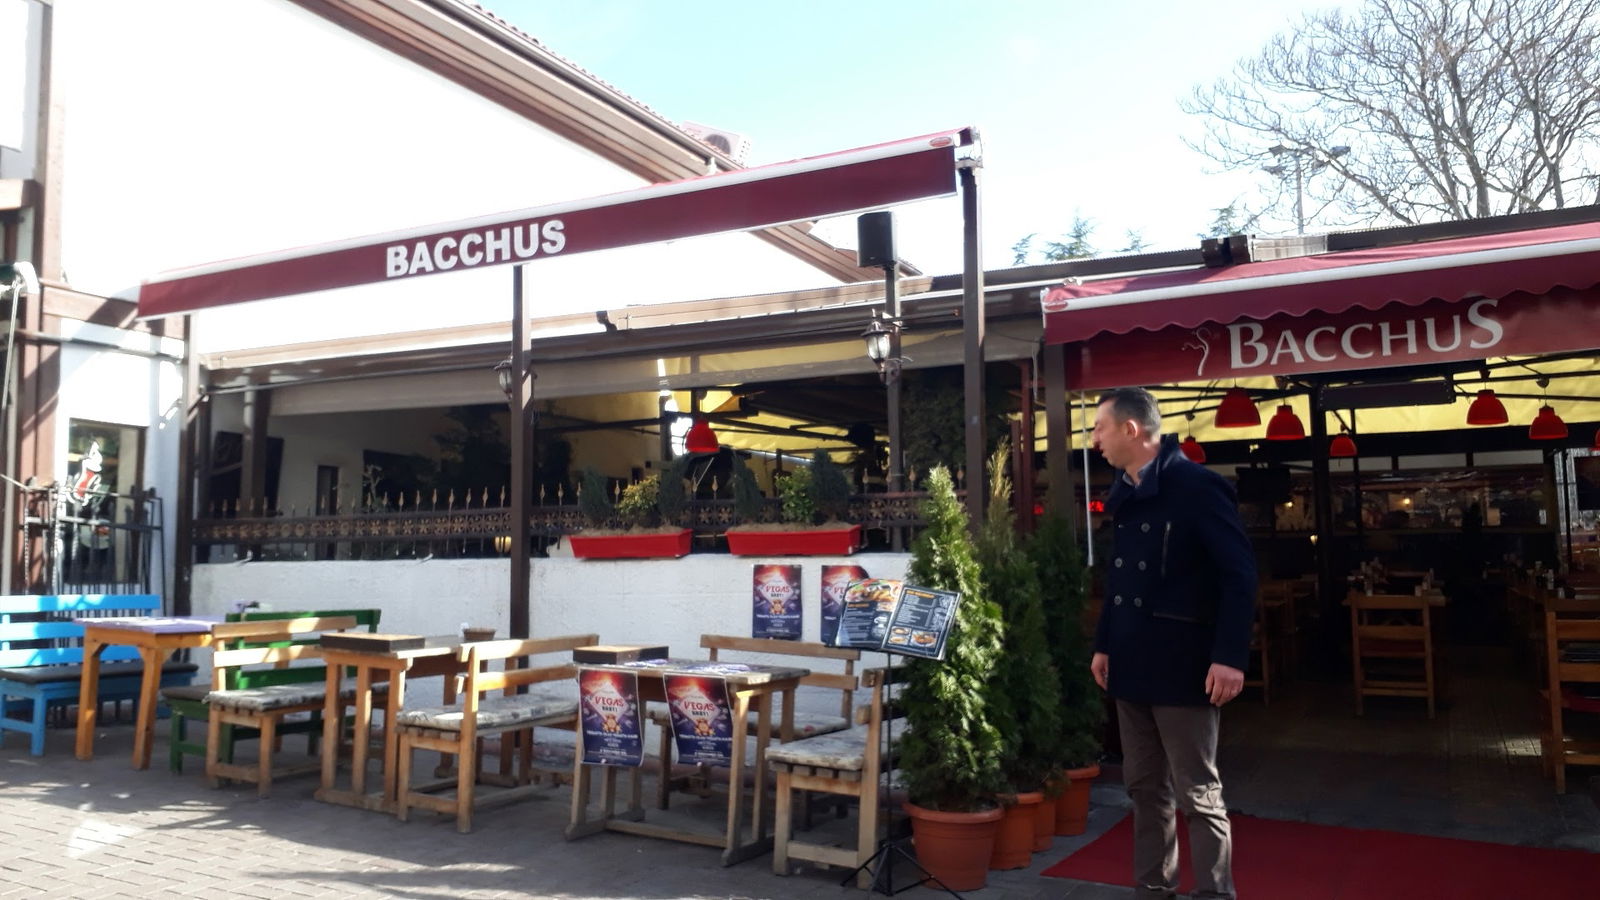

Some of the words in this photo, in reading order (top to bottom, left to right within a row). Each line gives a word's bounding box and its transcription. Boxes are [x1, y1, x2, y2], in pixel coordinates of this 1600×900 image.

[386, 219, 566, 278] BACCHUS
[1226, 298, 1504, 369] BACCHUS
[765, 585, 790, 593] VEGAS
[594, 696, 624, 707] VEGAS
[684, 701, 715, 711] VEGAS
